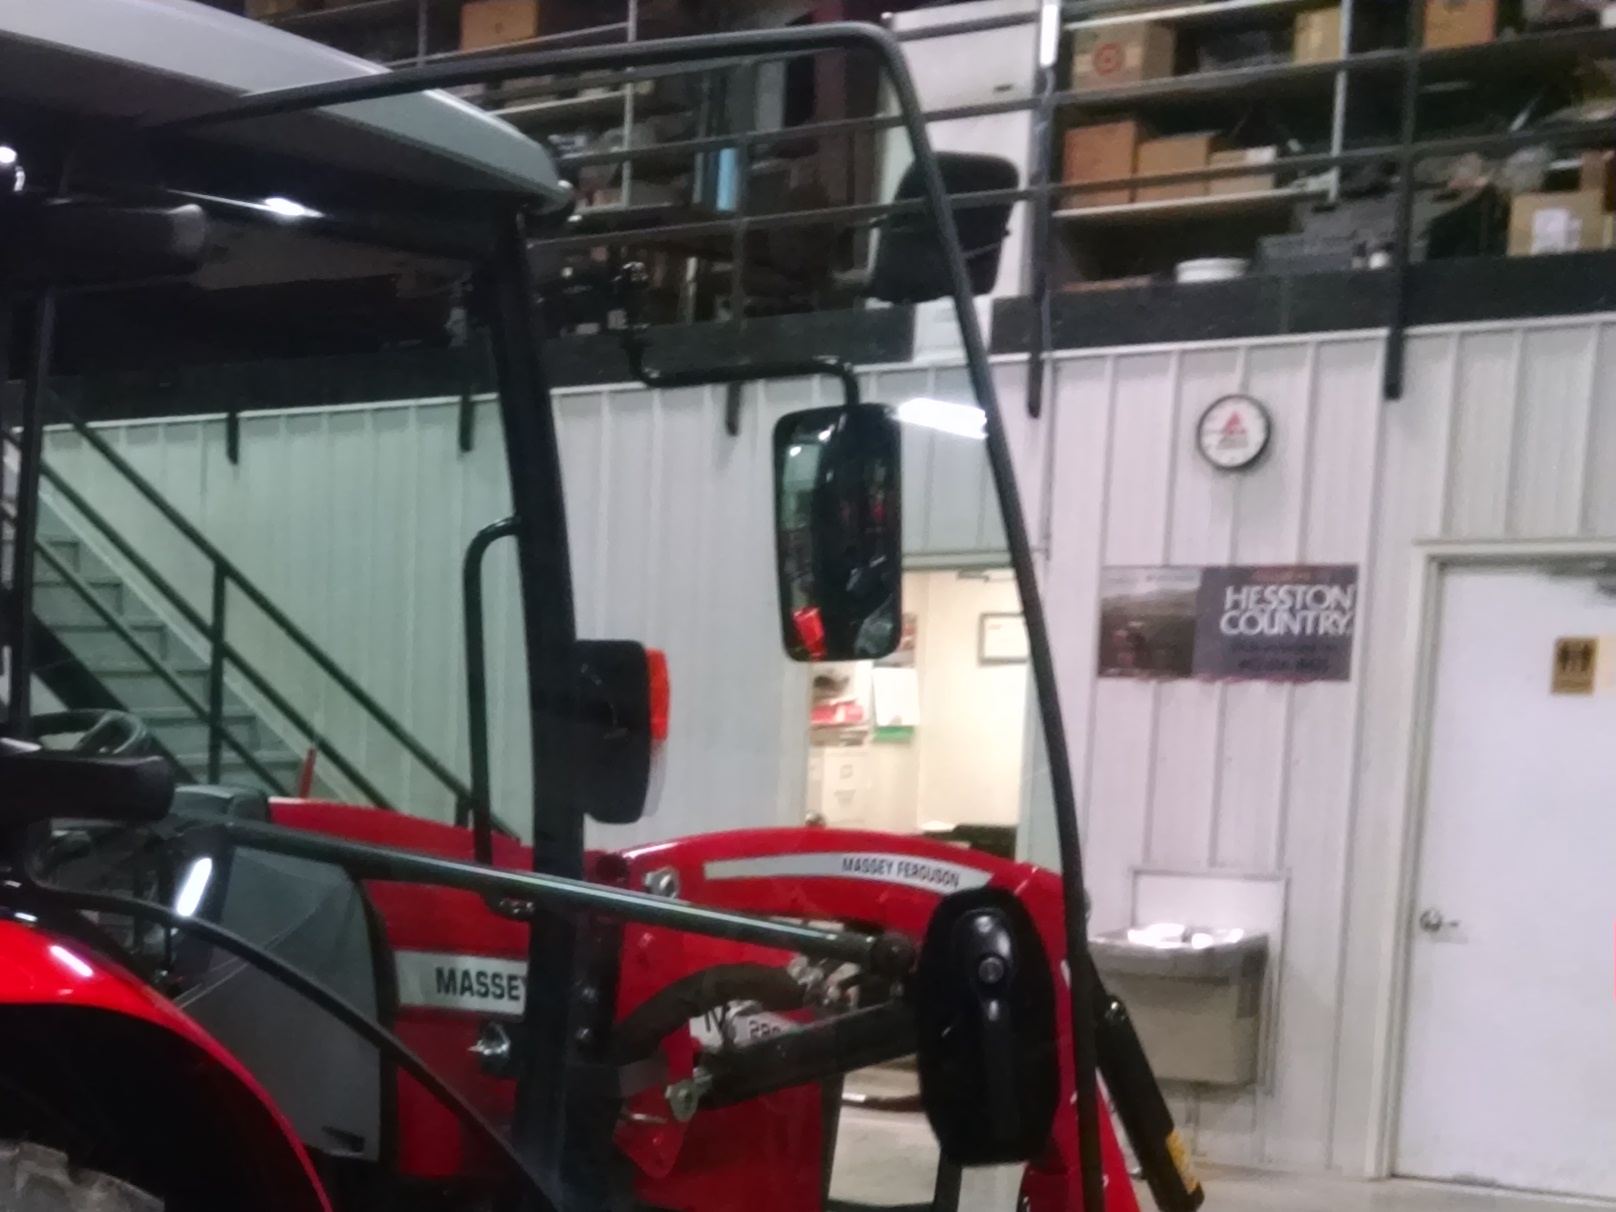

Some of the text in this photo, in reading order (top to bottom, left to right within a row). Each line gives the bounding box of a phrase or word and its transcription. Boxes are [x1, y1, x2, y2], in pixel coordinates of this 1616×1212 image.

[1224, 584, 1356, 610] HESSTON
[841, 857, 961, 888] MASSEY FERGUSON
[435, 965, 526, 1003] MASSE
